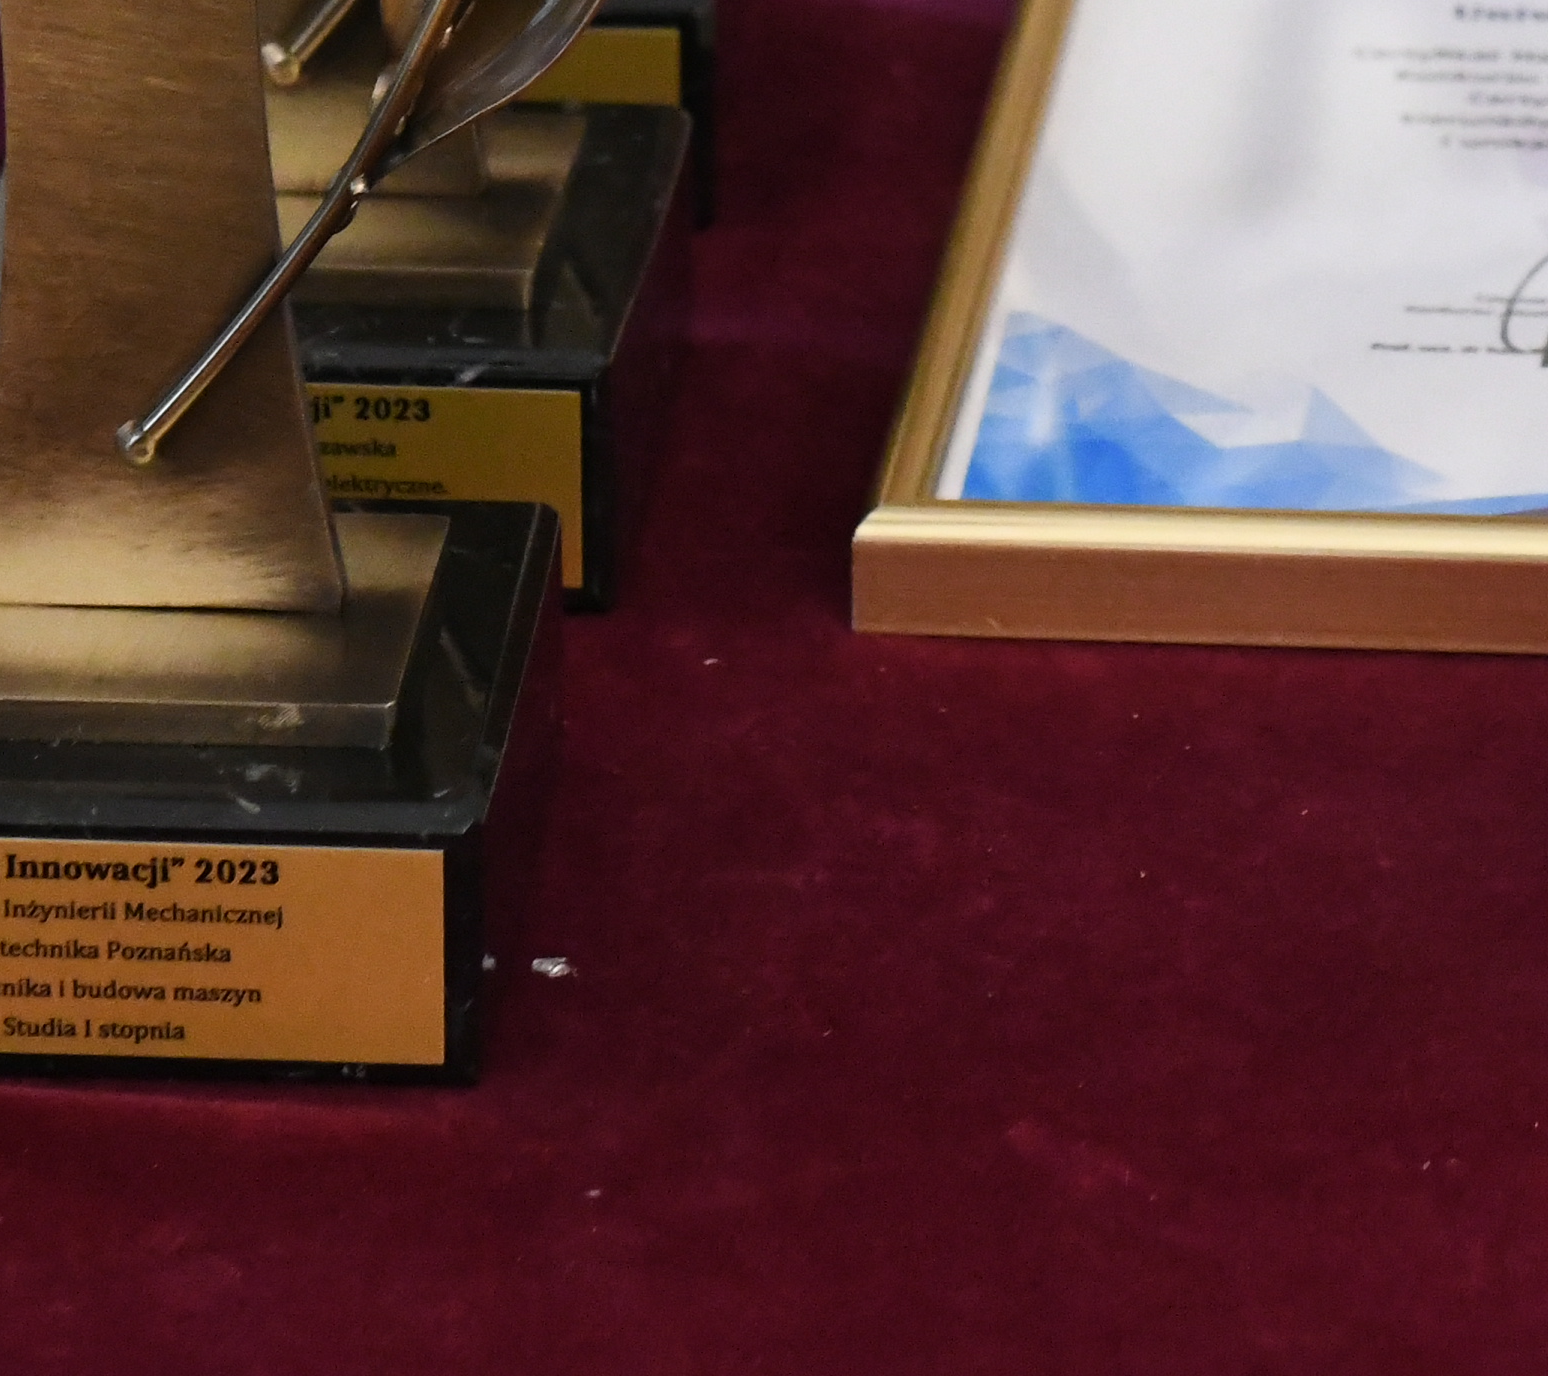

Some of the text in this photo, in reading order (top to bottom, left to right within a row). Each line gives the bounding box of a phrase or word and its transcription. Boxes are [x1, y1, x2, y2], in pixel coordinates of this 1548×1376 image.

[355, 395, 431, 422] 2023
[195, 858, 280, 886] 2023
[4, 898, 117, 924] Inżynierii
[124, 901, 283, 931] Mechanicznej
[107, 940, 232, 964] Poznańska
[58, 979, 66, 998] i
[72, 978, 166, 1002] budowa
[173, 986, 262, 1008] maszyn
[3, 1016, 186, 1046] Studia I stopnia
